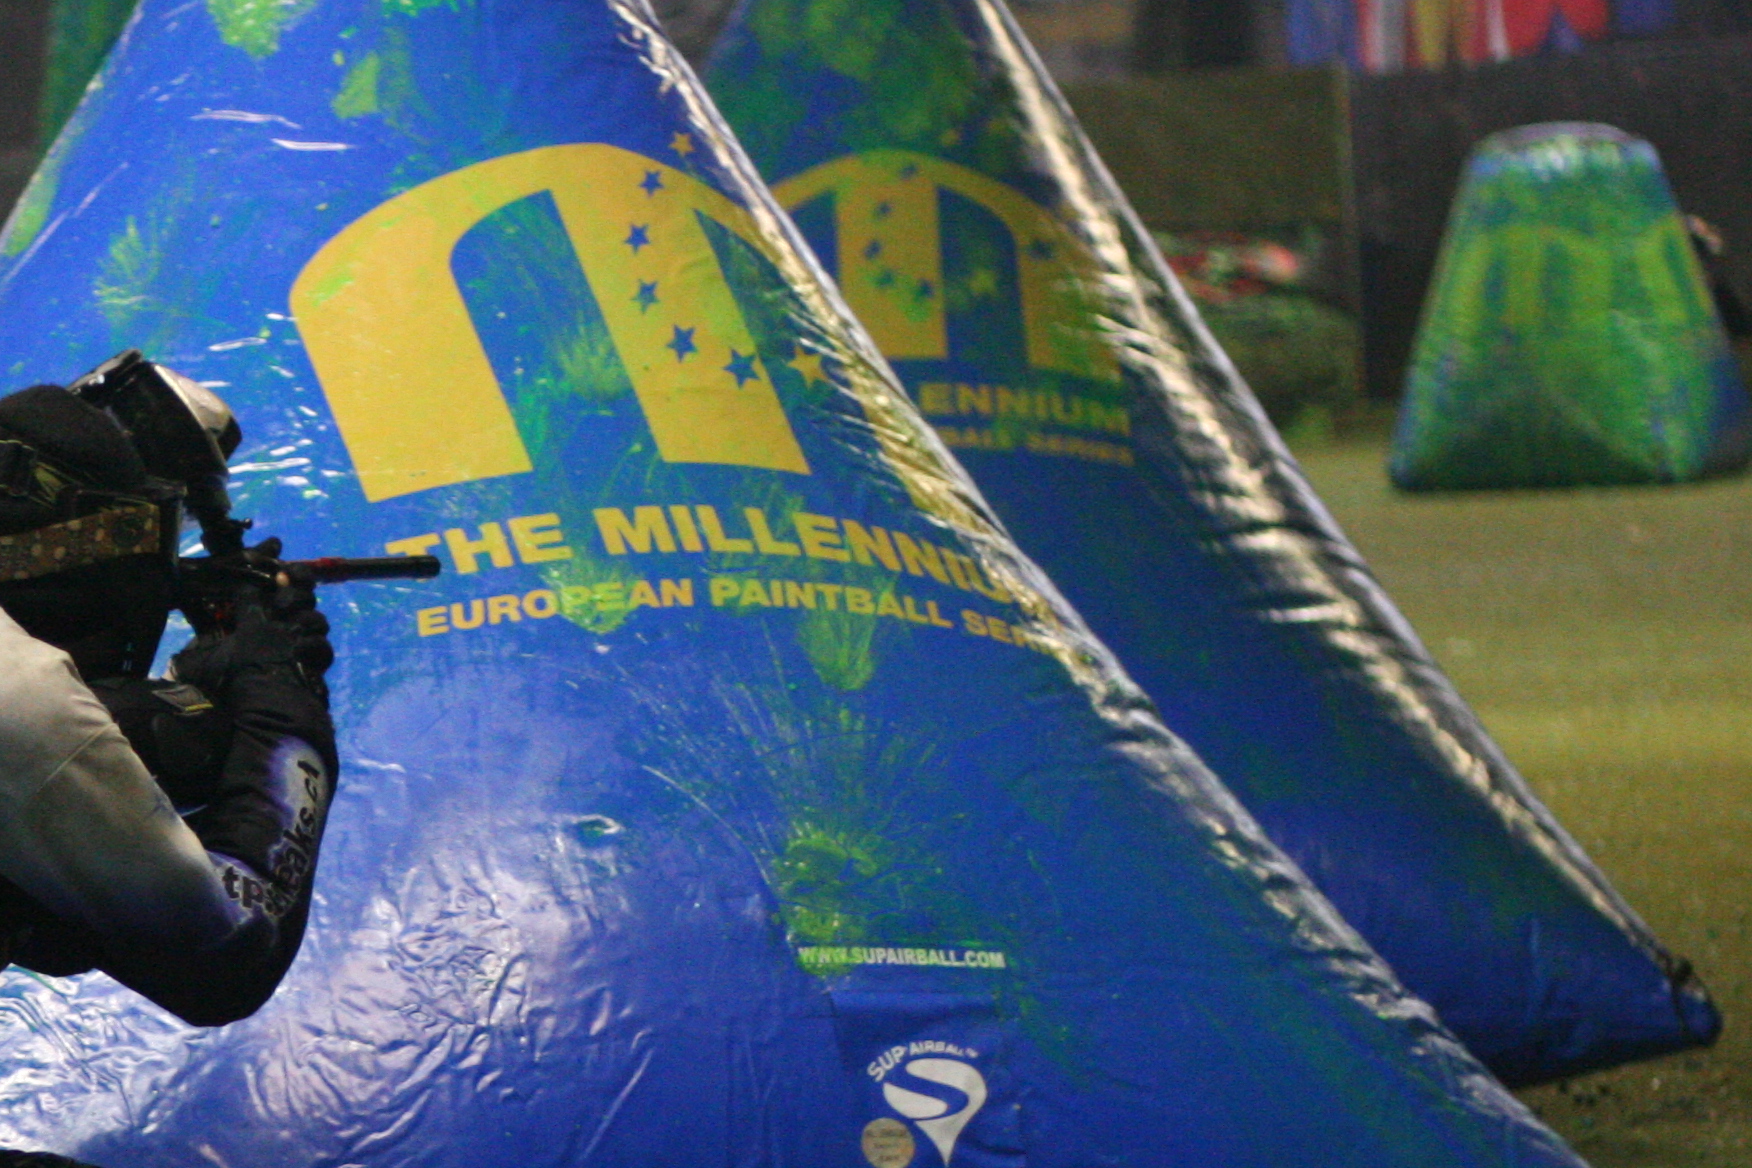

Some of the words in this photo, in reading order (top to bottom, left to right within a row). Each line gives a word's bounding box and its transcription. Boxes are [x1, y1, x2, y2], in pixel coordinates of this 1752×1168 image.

[919, 382, 1131, 437] ENNIUM
[593, 504, 1014, 604] MILLENNIU
[416, 578, 694, 637] EUROPEAN
[709, 578, 954, 629] PAINTBALL
[798, 946, 1007, 968] WWW.SUPAIRBALL.COM
